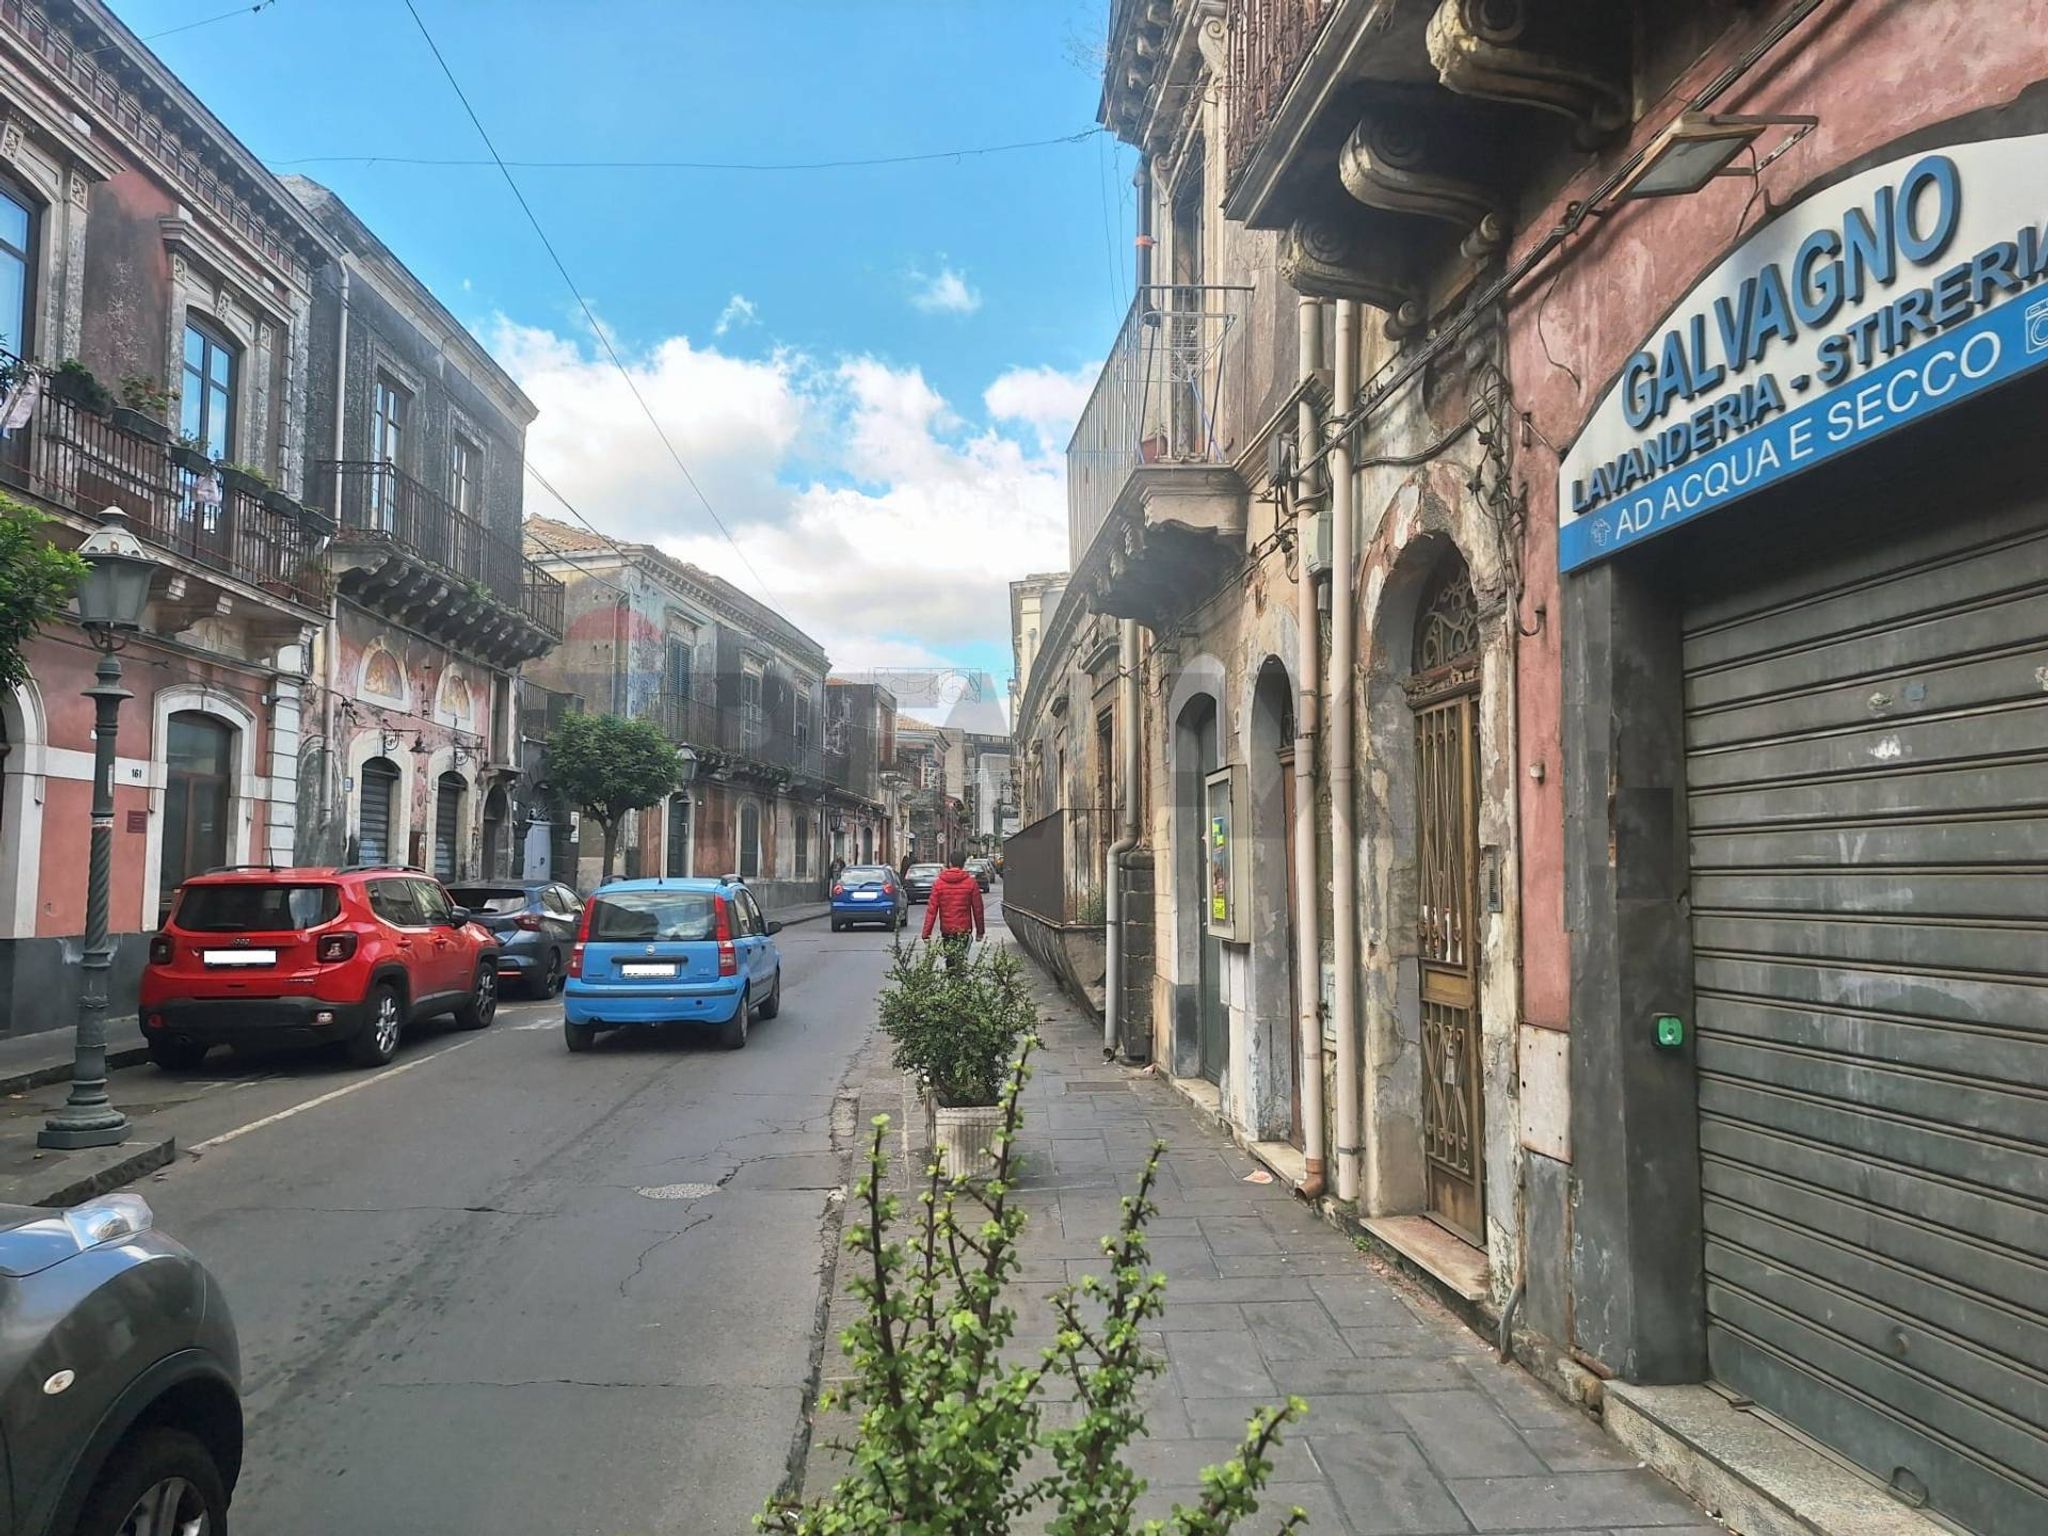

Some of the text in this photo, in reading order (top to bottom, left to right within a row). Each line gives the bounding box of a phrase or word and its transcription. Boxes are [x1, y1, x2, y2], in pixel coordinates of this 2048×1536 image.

[1621, 154, 1962, 430] GALVAGNO
[1571, 373, 1786, 514] LAVANDERIA
[1615, 330, 2001, 541] AD ACQUA E SECCO
